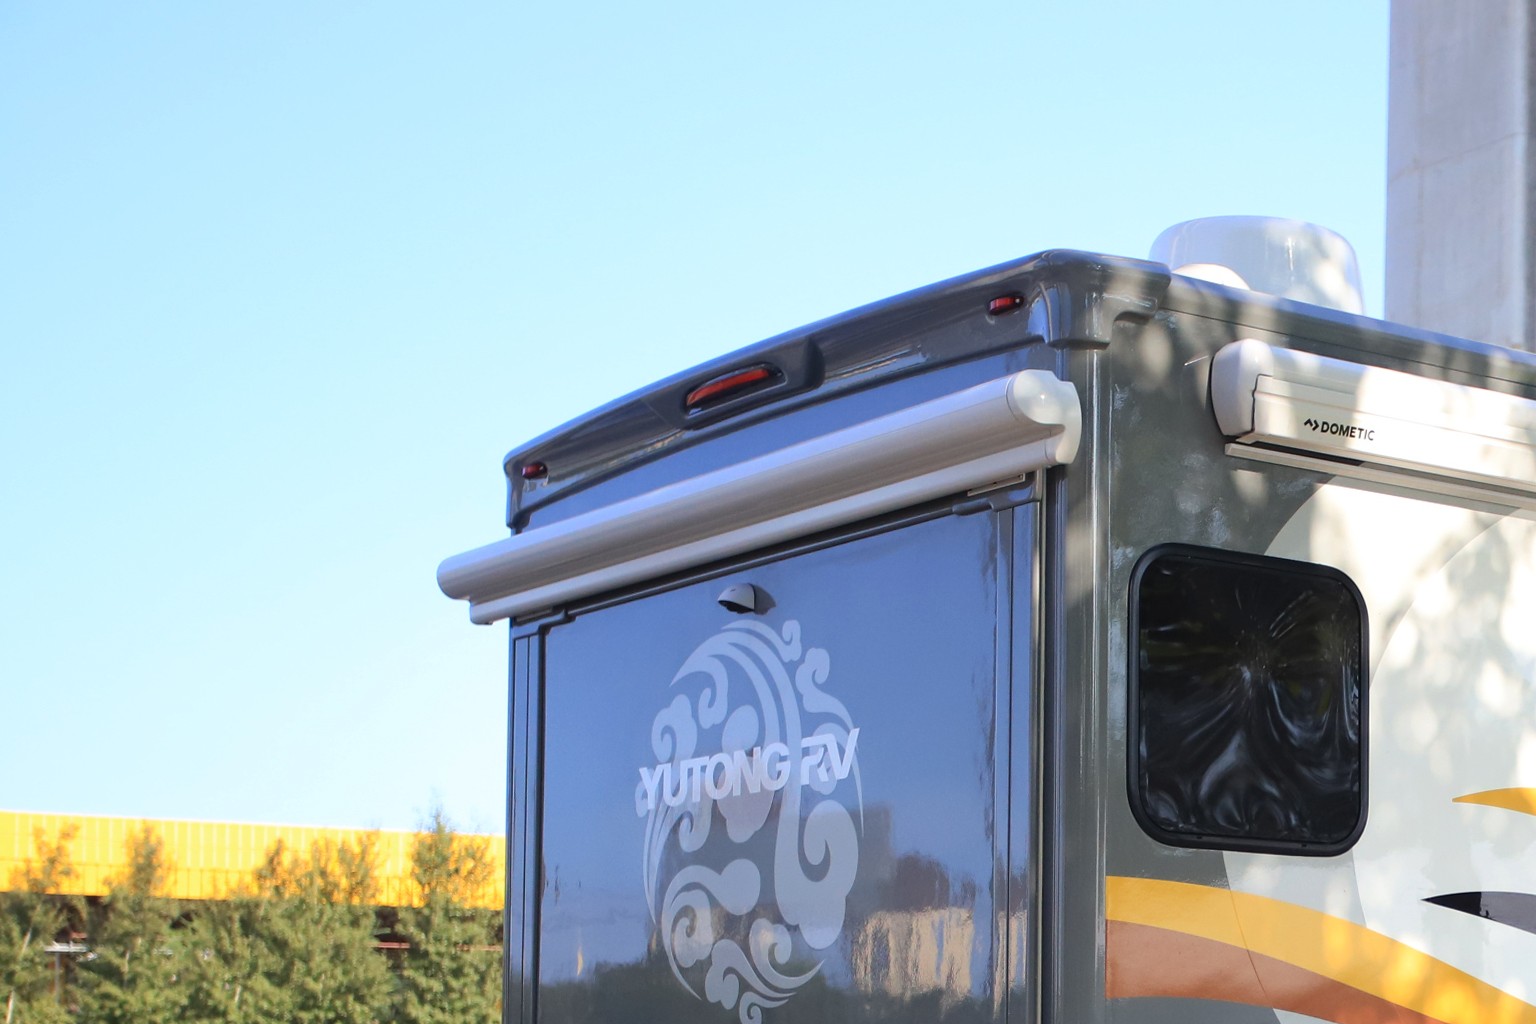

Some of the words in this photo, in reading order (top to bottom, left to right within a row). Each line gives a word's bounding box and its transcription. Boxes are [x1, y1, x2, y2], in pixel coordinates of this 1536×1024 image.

[1320, 421, 1375, 441] DOMETIC
[639, 742, 791, 811] YUTONG
[801, 727, 860, 786] RV
